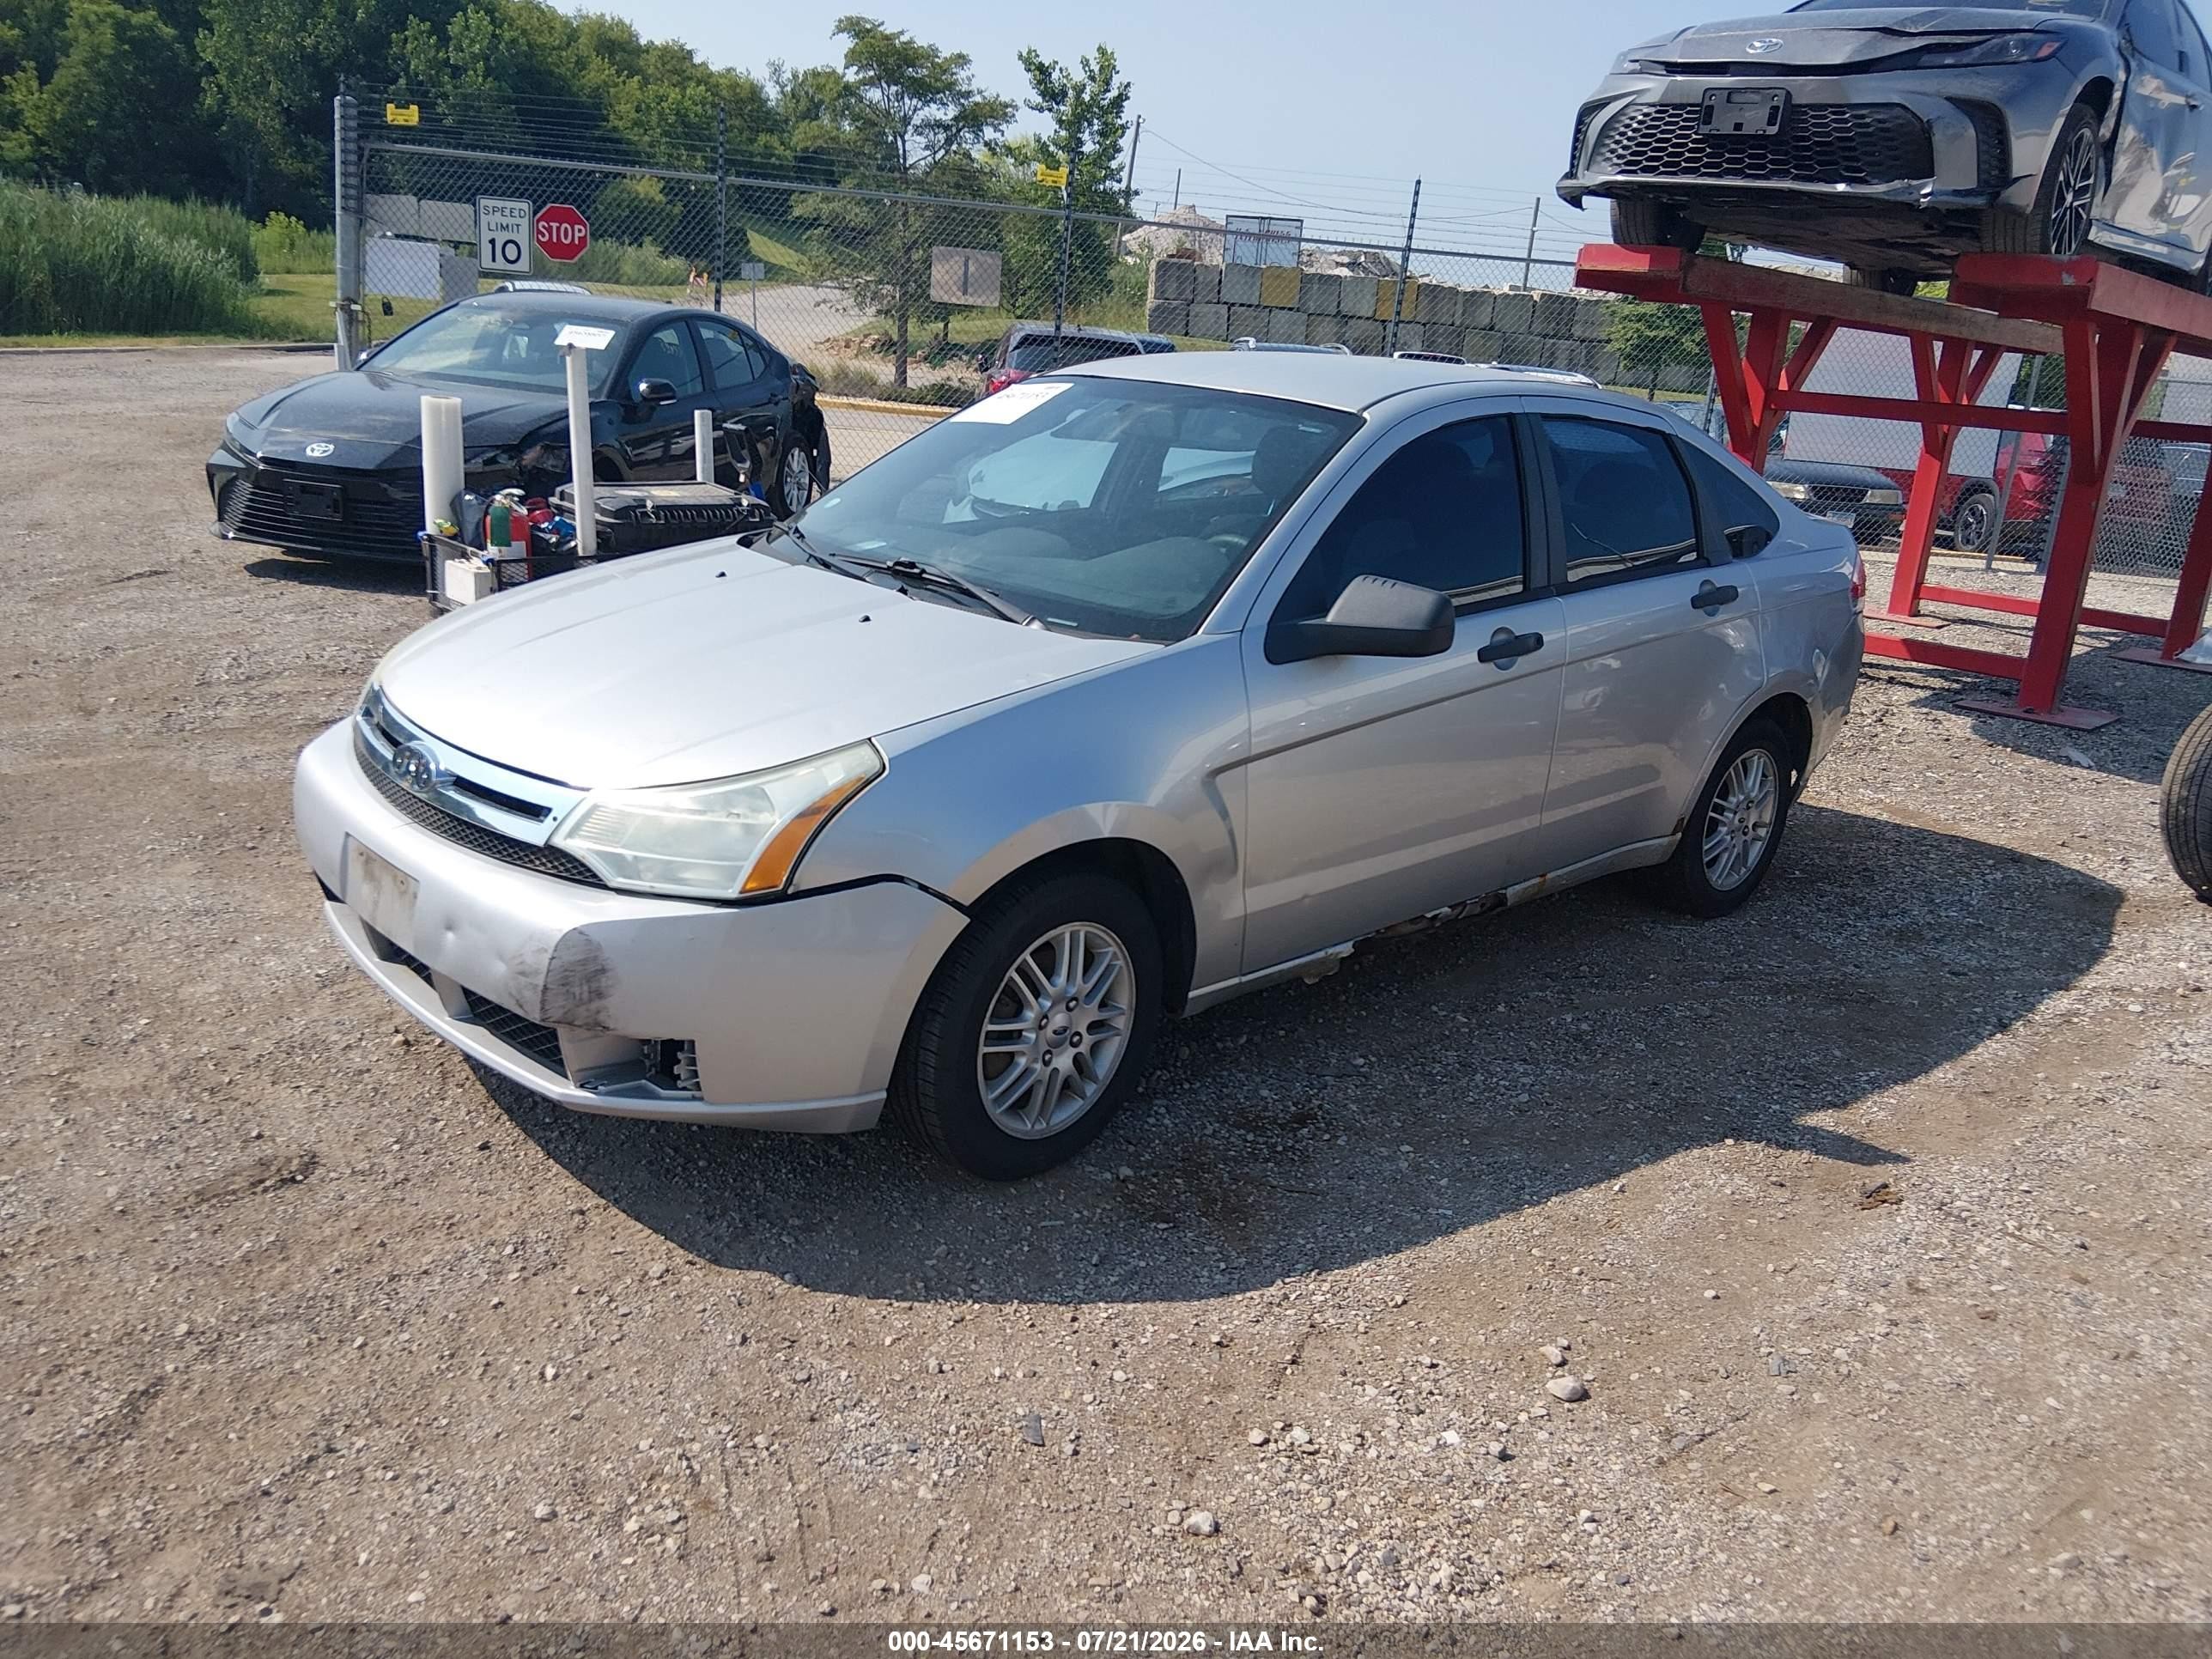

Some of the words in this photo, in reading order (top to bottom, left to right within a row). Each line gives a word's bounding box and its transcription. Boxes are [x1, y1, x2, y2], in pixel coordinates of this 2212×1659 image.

[483, 205, 526, 218] SPEED
[487, 222, 522, 234] LIMIT
[538, 221, 586, 245] STOP
[488, 237, 522, 264] 10
